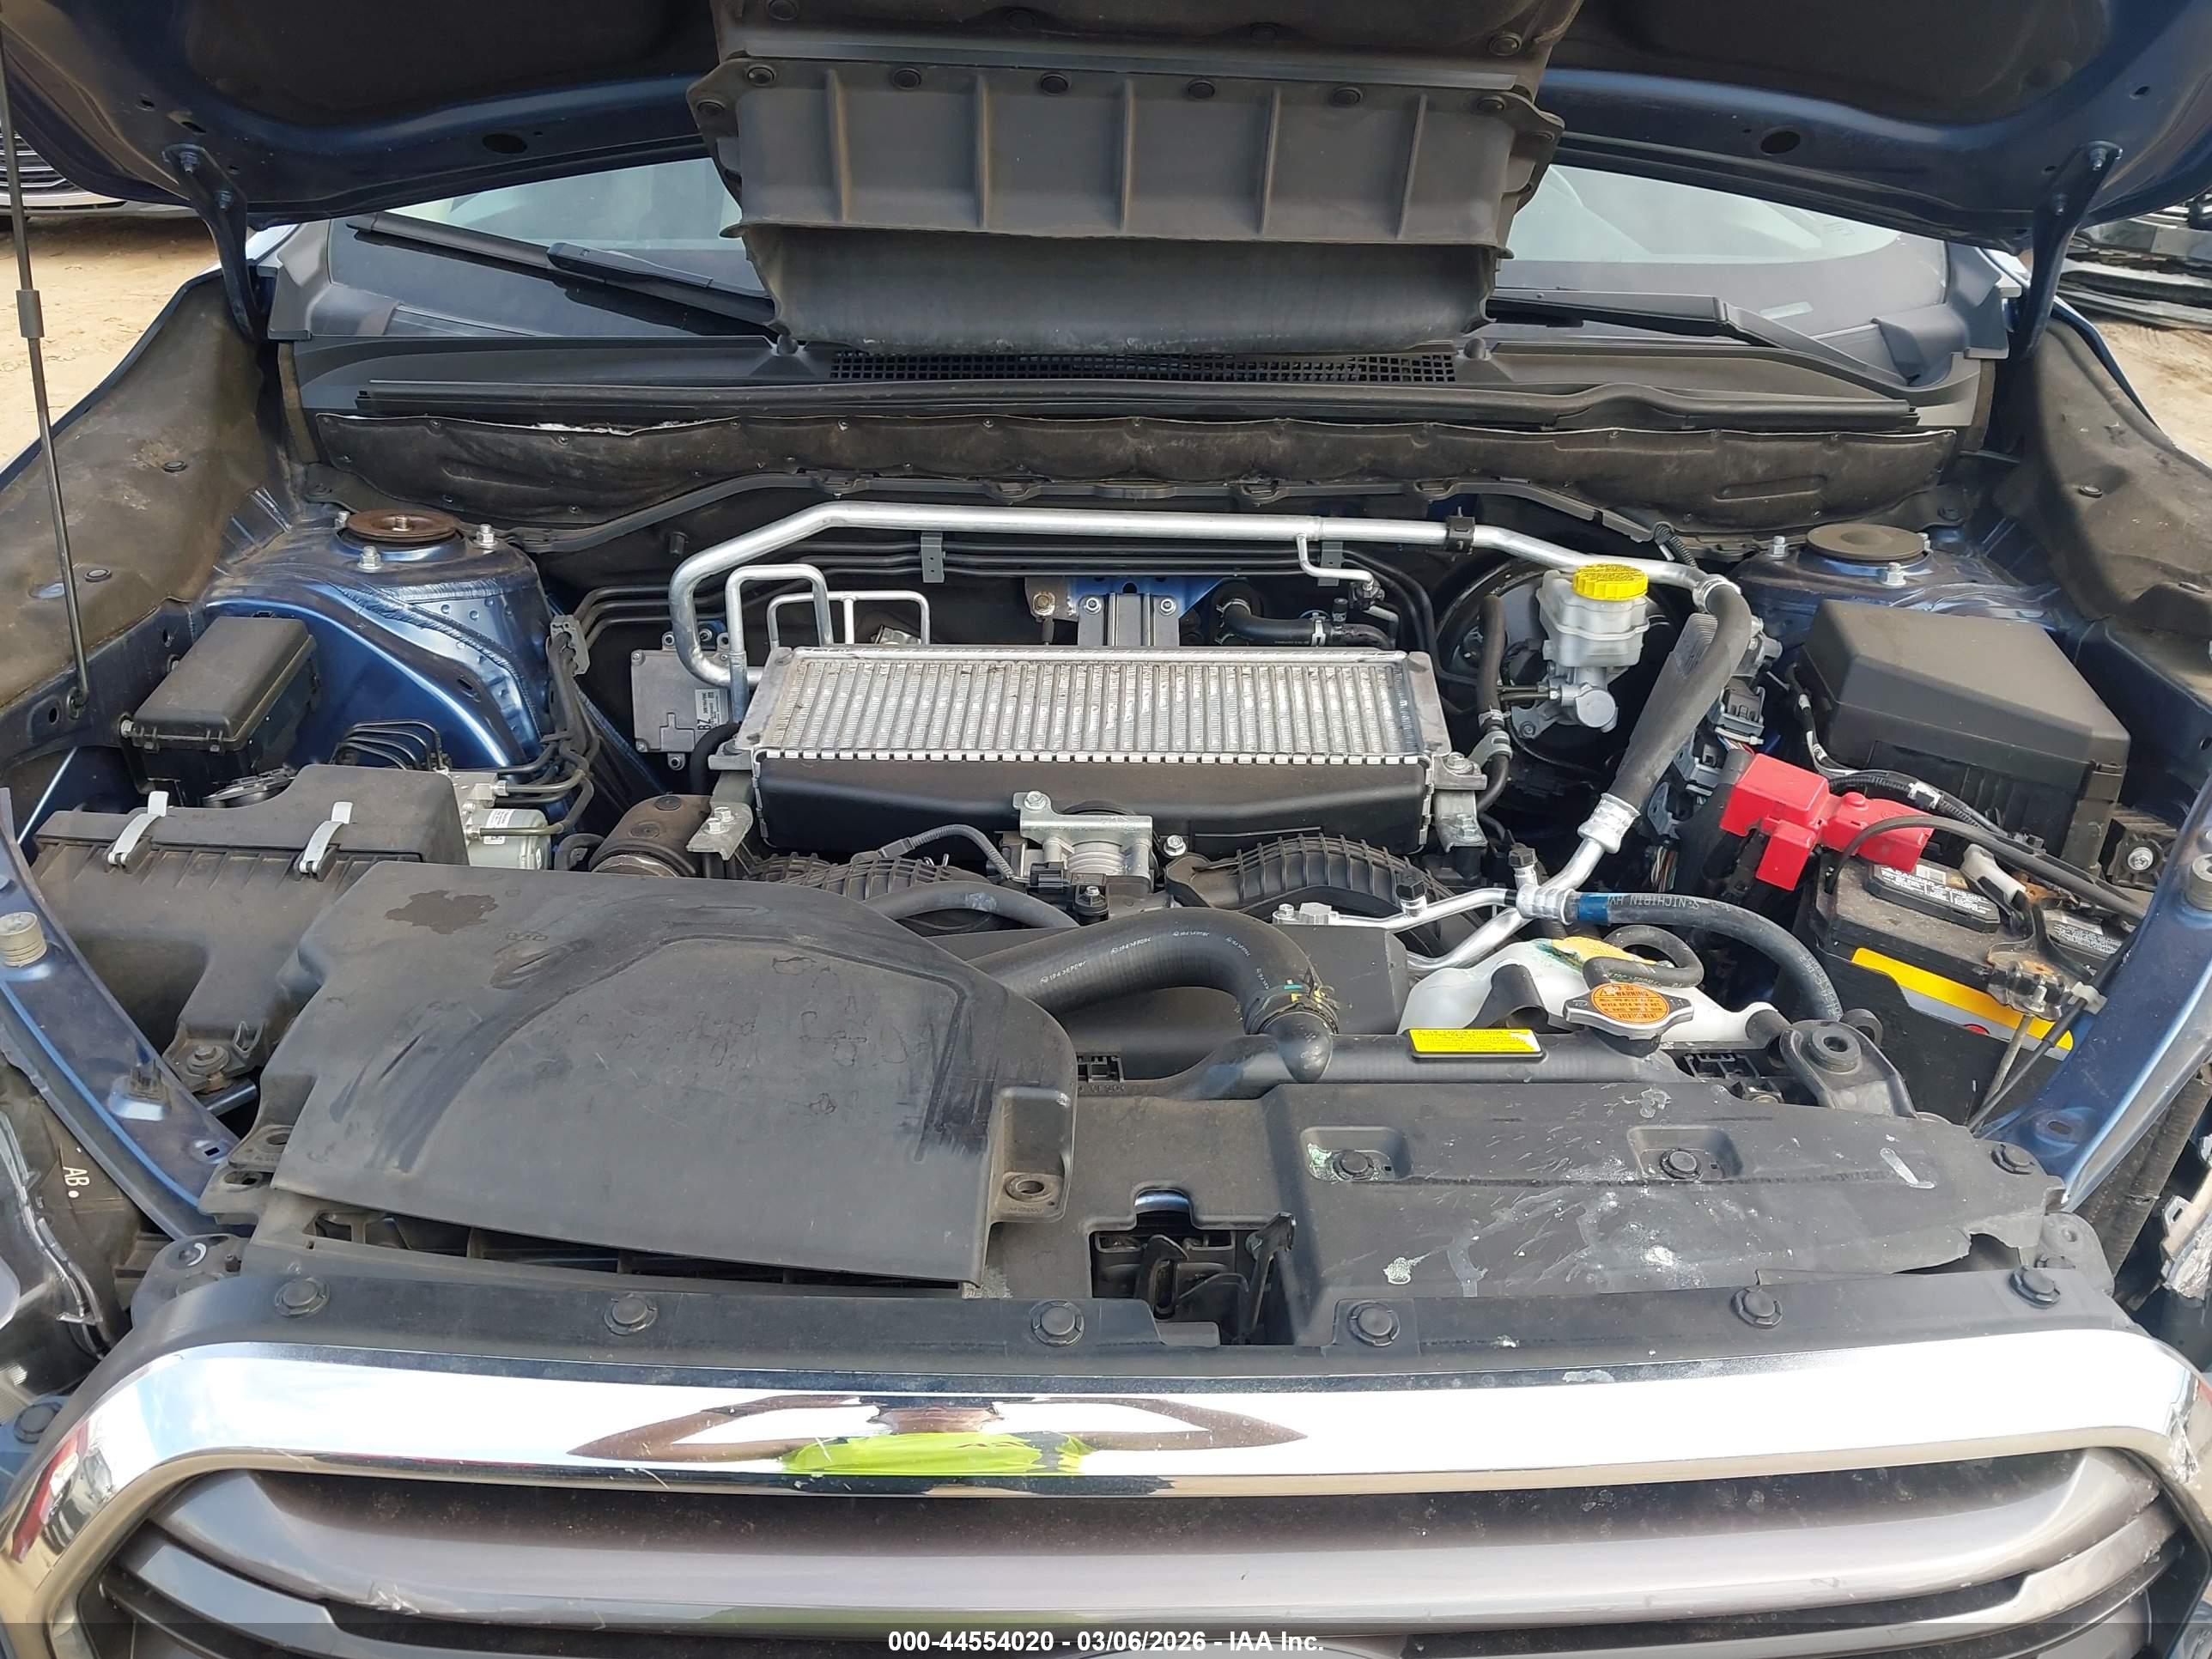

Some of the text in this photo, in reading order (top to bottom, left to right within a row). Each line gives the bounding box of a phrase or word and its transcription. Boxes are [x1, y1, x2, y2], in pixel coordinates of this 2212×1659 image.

[697, 719, 711, 730] BZ
[1629, 895, 1686, 908] NICHIRIN
[63, 1166, 90, 1187] AB
